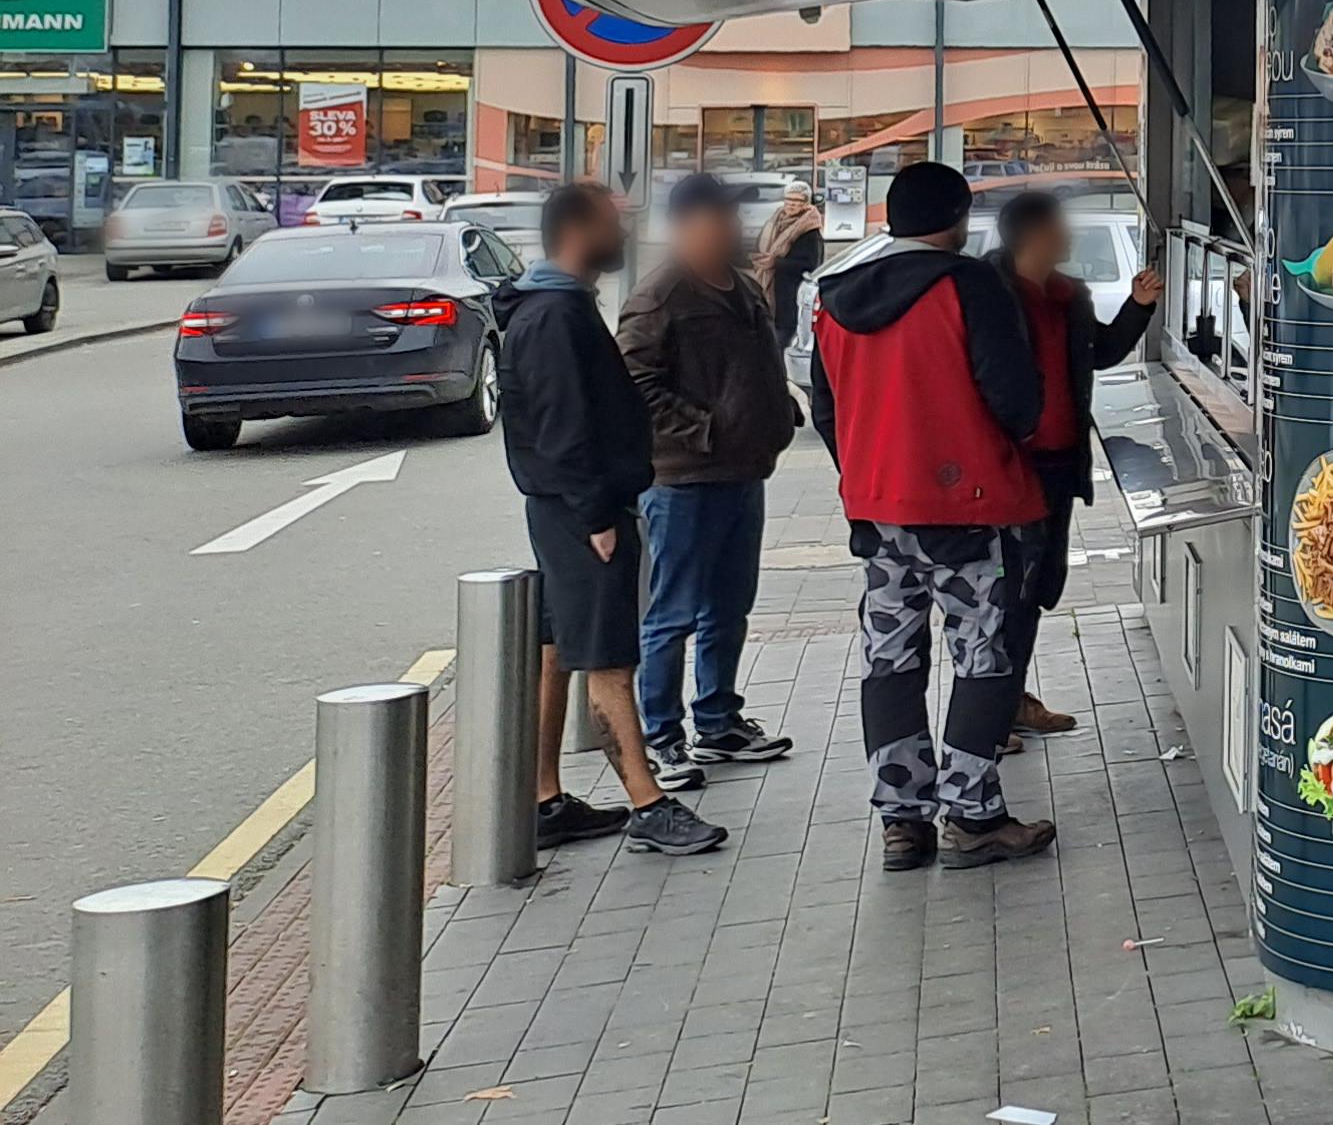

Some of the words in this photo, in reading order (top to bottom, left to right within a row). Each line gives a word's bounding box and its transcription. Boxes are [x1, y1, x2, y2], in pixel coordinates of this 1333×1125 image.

[0, 13, 83, 30] MANN
[309, 111, 356, 121] SLEVA
[309, 121, 337, 136] 30
